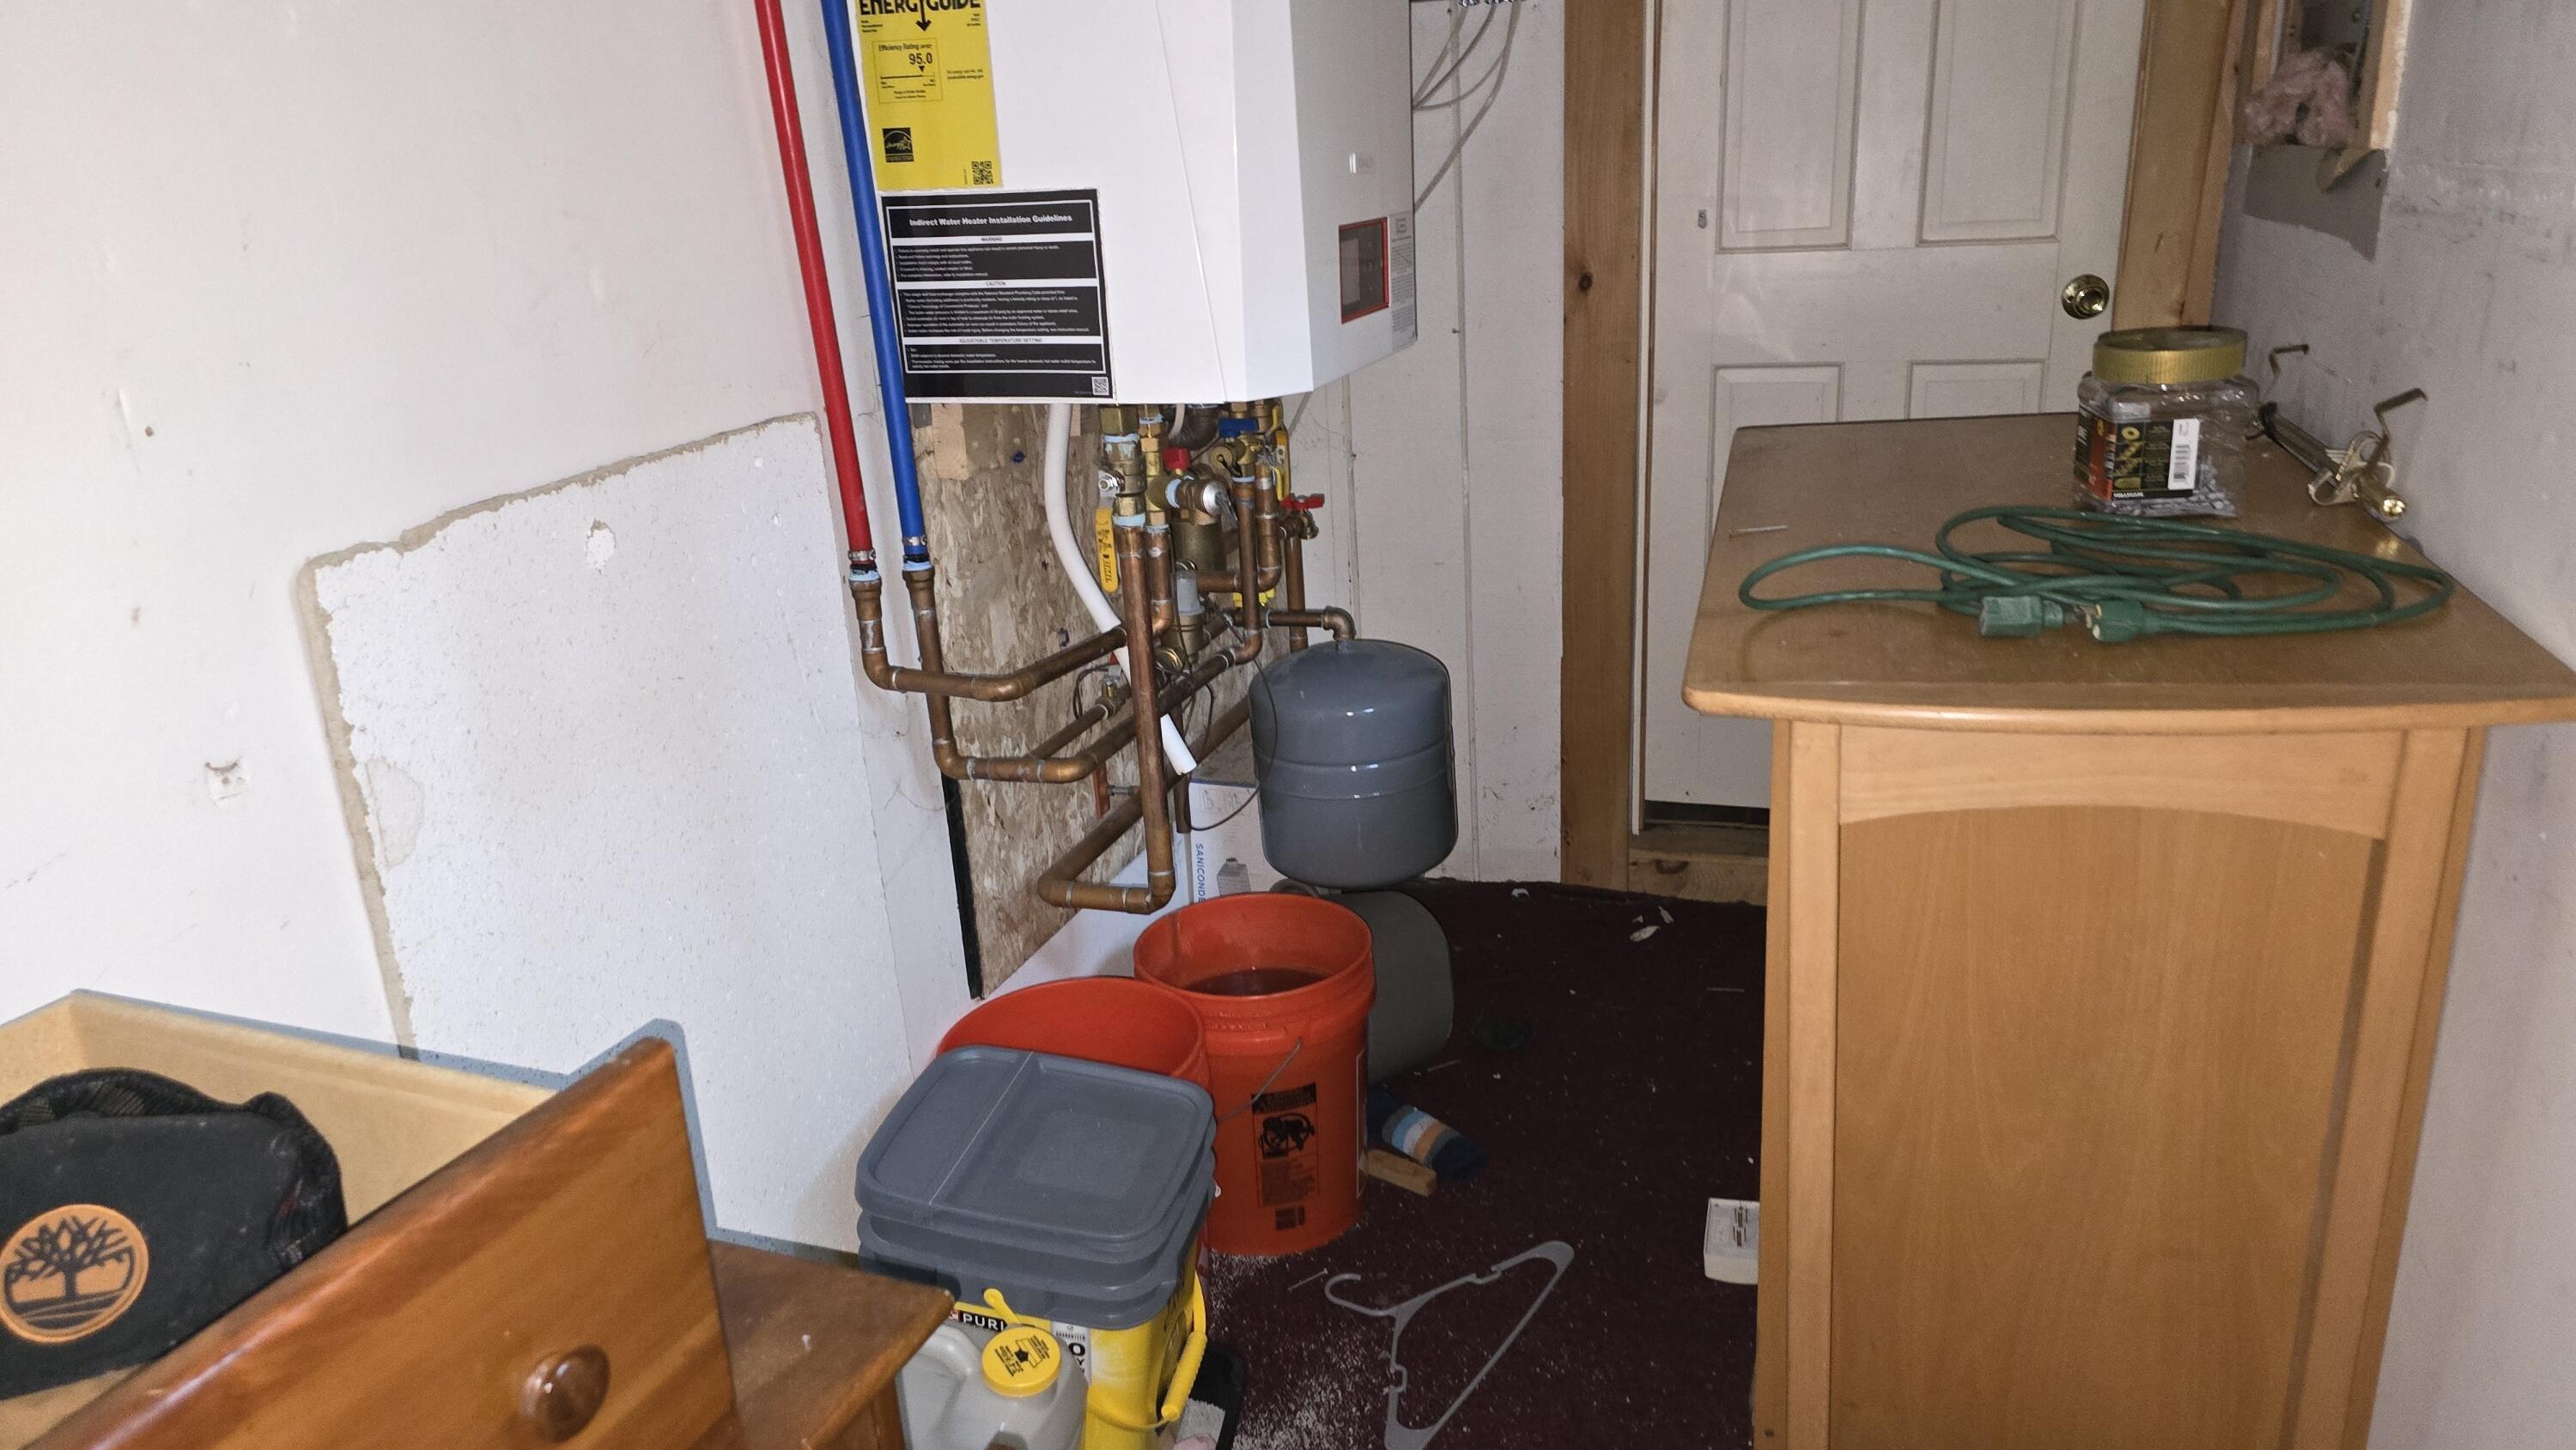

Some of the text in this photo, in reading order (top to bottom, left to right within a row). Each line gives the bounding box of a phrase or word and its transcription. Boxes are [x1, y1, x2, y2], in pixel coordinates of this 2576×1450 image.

[908, 52, 933, 65] 95.0
[1032, 215, 1072, 223] Guidelines
[1055, 1331, 1086, 1340] GUARANTEED
